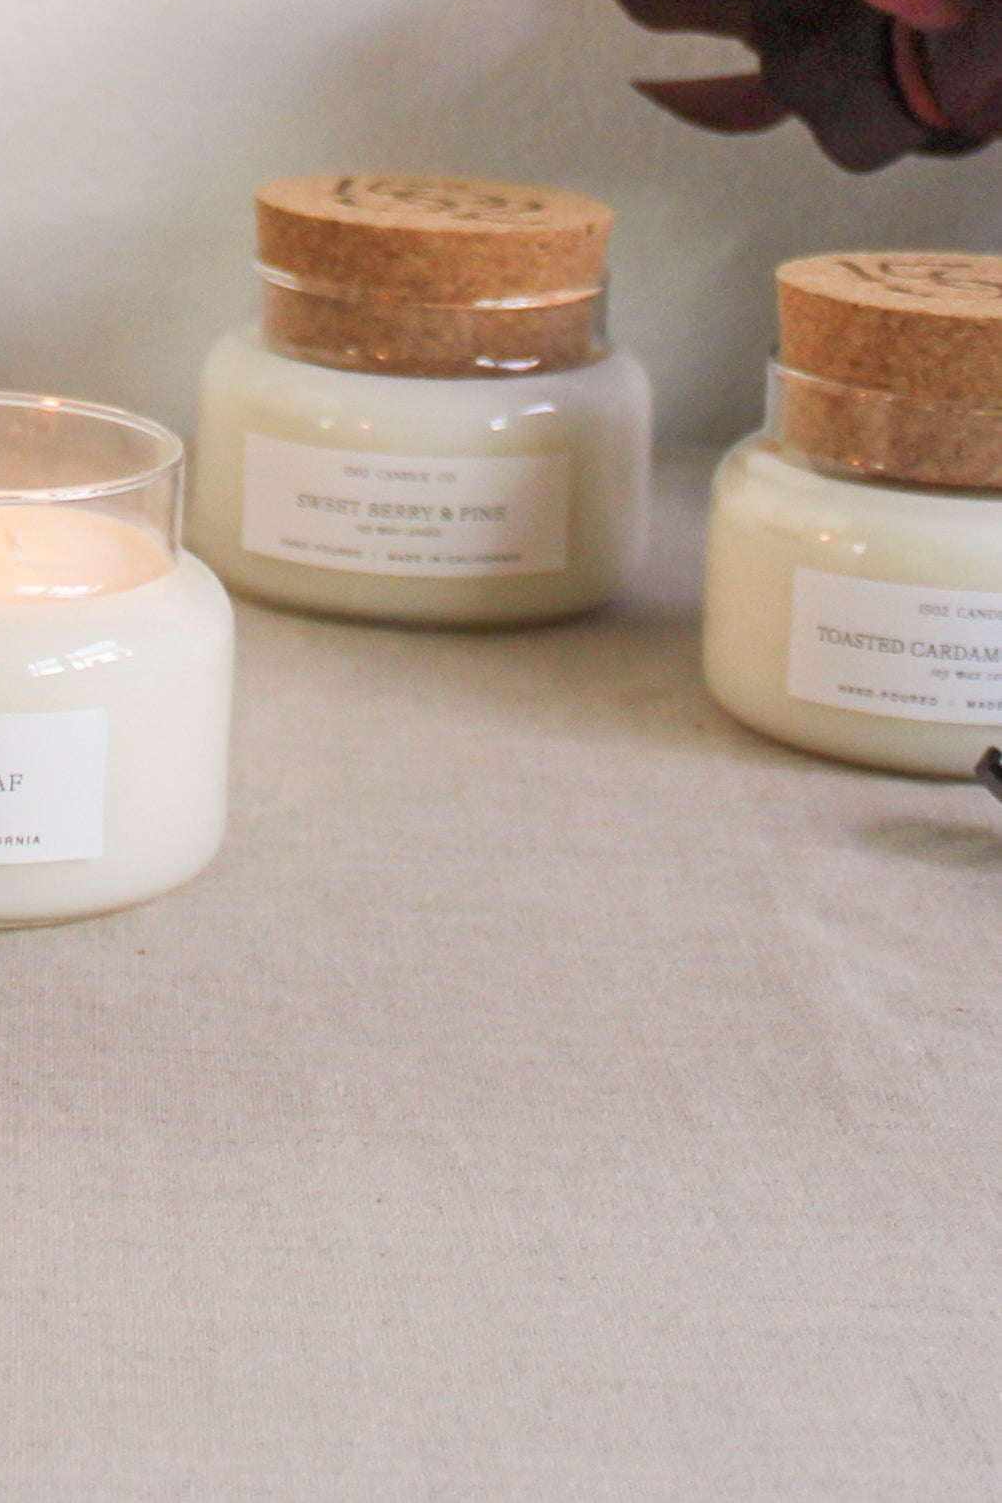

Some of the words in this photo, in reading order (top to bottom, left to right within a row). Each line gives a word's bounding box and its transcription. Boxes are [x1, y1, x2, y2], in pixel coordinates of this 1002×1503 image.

[297, 493, 360, 517] SWEET
[368, 499, 435, 522] BERRY
[439, 504, 455, 523] &
[459, 505, 508, 523] PINE
[817, 624, 905, 656] TOASTED
[909, 641, 1002, 664] CARDAM
